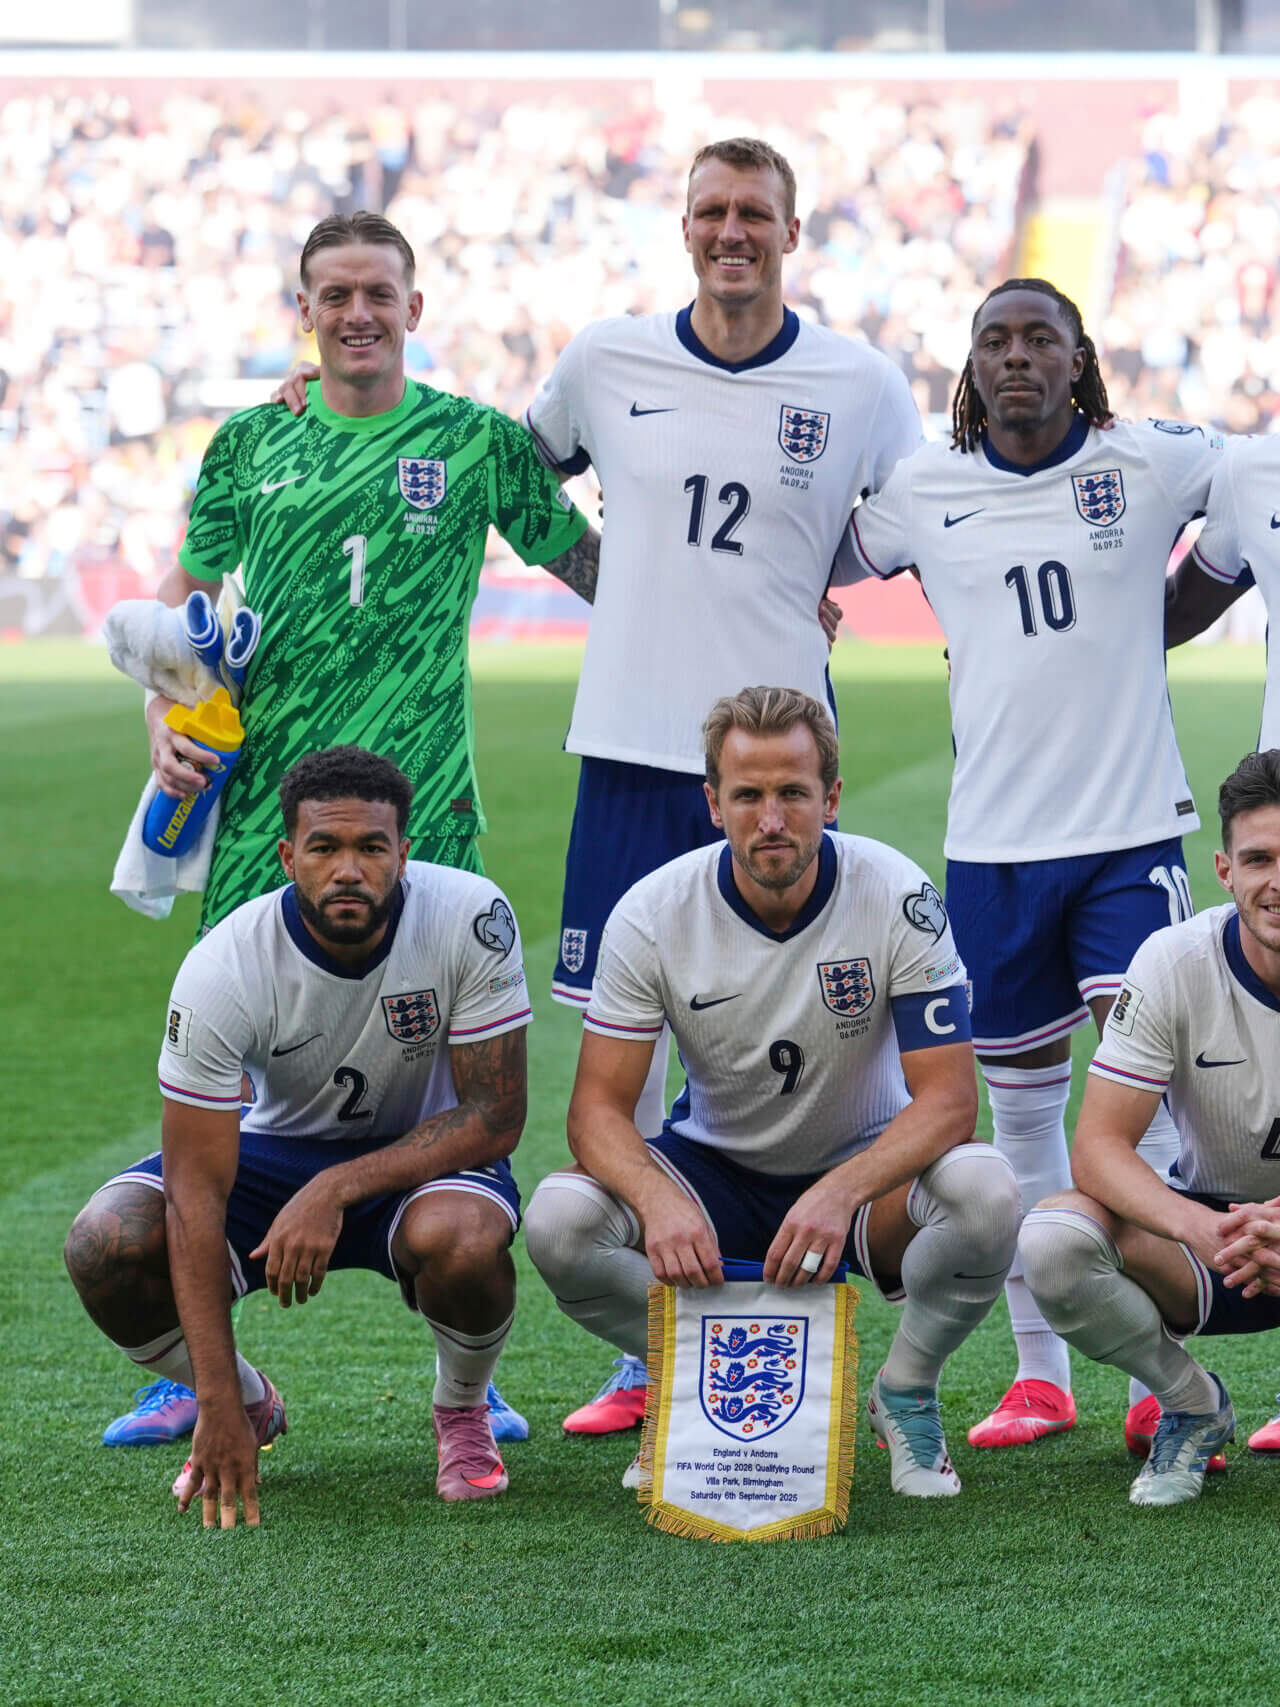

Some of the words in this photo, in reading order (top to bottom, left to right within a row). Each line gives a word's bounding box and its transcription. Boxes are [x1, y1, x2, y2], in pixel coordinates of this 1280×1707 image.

[780, 465, 814, 479] ANDORRA
[780, 476, 809, 490] 06.09.25
[403, 511, 438, 525] ANDORRA
[684, 474, 751, 556] 12
[1089, 527, 1124, 541] ANDORRA
[1093, 538, 1123, 551] 06.09.25
[343, 535, 367, 607] 1
[1004, 560, 1077, 637] 10
[1148, 865, 1195, 926] 10
[835, 1016, 872, 1030] ANDORRA
[924, 998, 956, 1035] C
[839, 1026, 869, 1040] 06.09.25
[769, 1040, 806, 1095] 9
[333, 1066, 374, 1123] 2
[713, 1448, 741, 1459] England
[750, 1449, 778, 1459] Andorra
[676, 1462, 692, 1471] FIFA
[695, 1462, 715, 1472] World
[717, 1463, 732, 1474] Cup
[734, 1463, 752, 1472] 2026
[755, 1464, 789, 1475] Qualifying
[792, 1464, 815, 1474] Round
[706, 1477, 720, 1486] Villa
[722, 1477, 740, 1487] Park,
[743, 1477, 784, 1488] Birmingham
[690, 1490, 722, 1501] Saturday
[724, 1491, 737, 1500] 6th
[739, 1491, 777, 1502] September
[779, 1492, 798, 1502] 2025
